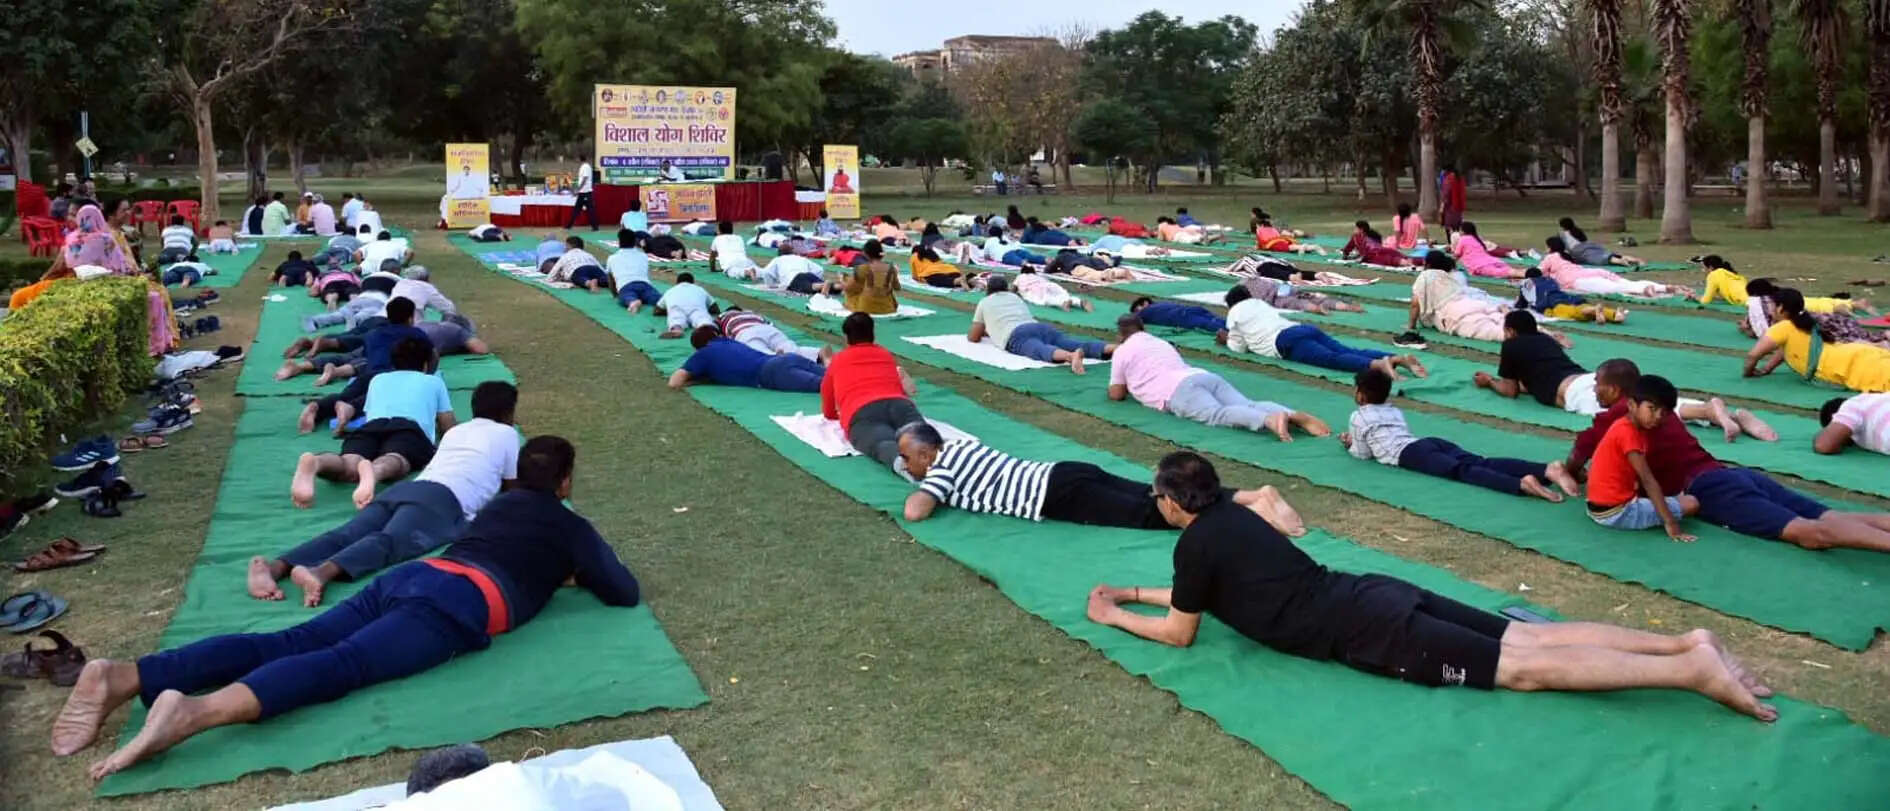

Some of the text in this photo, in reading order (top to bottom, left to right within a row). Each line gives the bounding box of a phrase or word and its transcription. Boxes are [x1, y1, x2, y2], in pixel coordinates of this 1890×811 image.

[604, 123, 727, 143] विशाल योग शिविर
